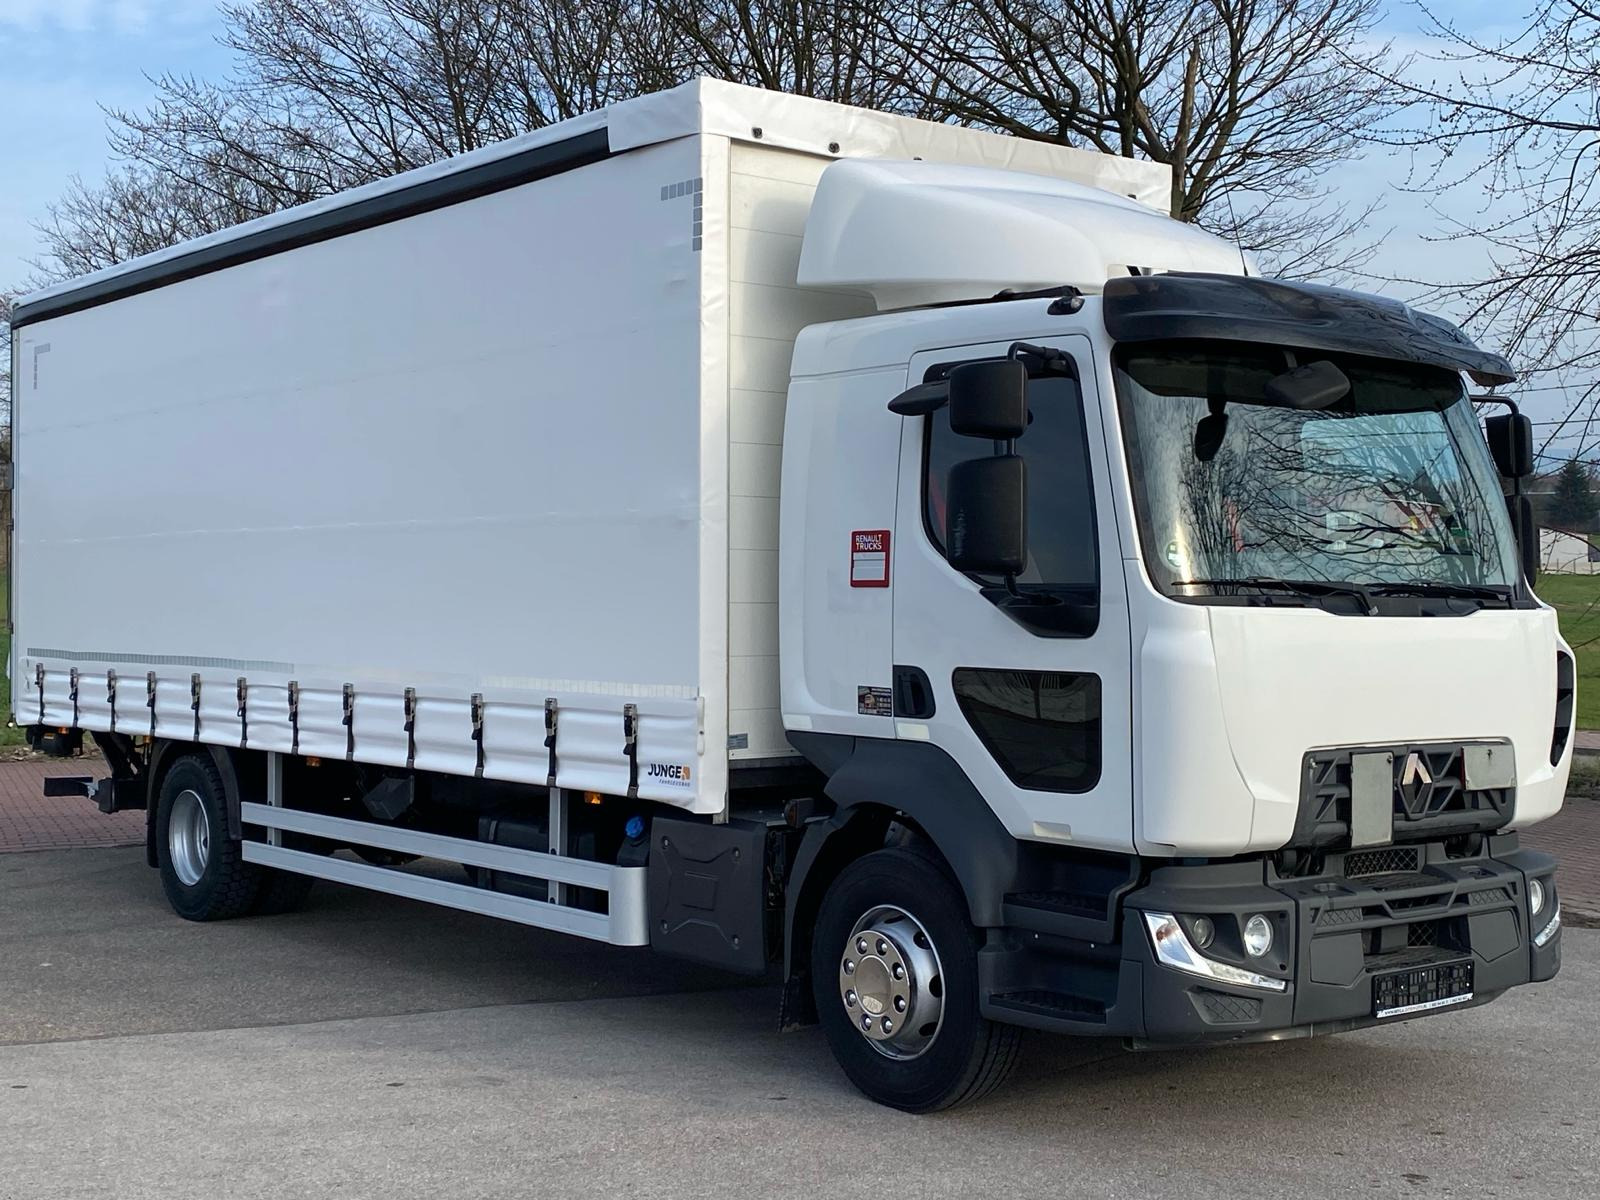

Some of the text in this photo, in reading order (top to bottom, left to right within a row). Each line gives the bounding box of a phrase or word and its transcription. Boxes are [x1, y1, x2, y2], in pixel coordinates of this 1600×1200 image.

[855, 534, 882, 543] RENAULT
[855, 542, 882, 550] TRUCKS
[648, 763, 682, 778] JUNGE
